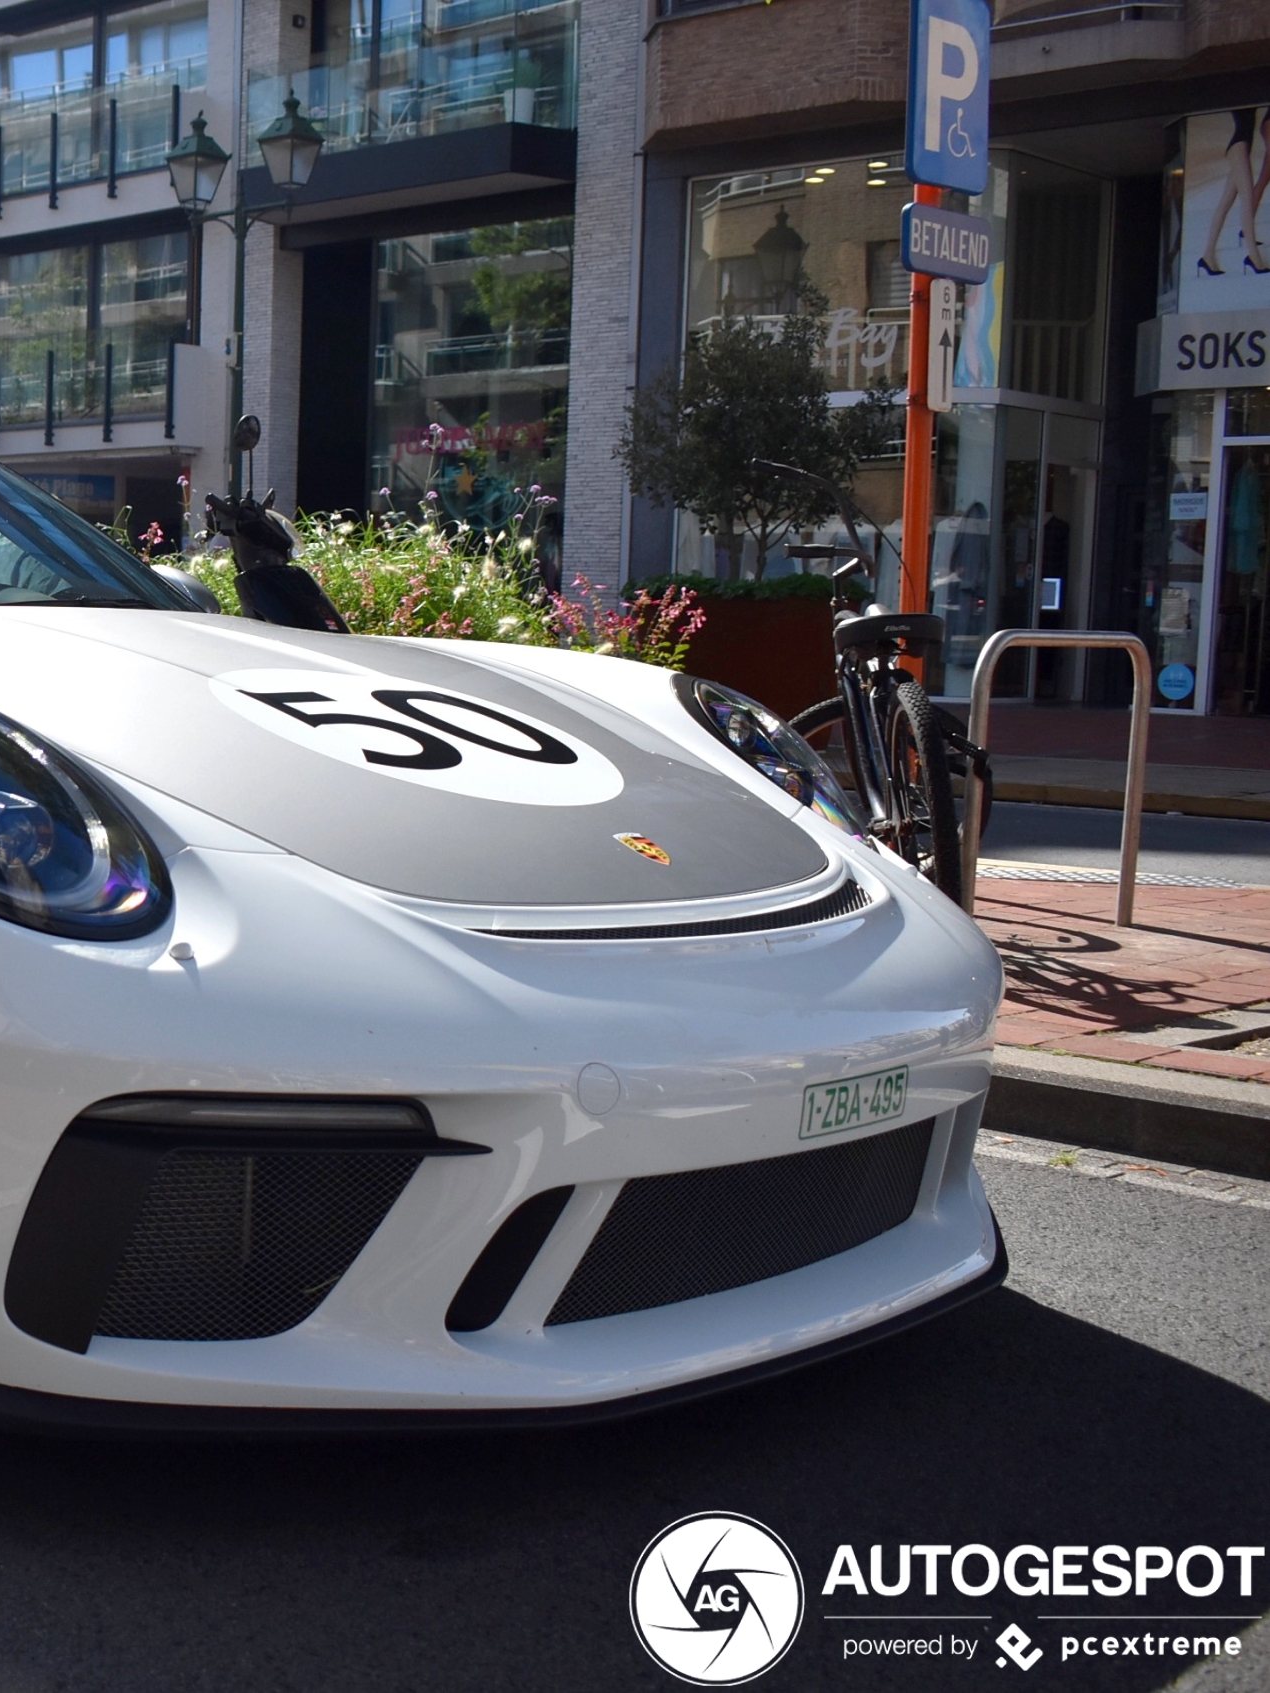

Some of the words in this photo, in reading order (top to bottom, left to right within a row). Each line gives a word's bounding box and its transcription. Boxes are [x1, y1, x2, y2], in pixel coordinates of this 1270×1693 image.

[924, 15, 979, 152] P
[911, 218, 989, 268] BETALEND
[941, 308, 951, 320] m
[943, 286, 951, 303] 6
[825, 307, 898, 367] Bay
[1176, 330, 1266, 370] SOKS
[235, 689, 578, 770] 50
[807, 1072, 904, 1132] 1-ZBA-495
